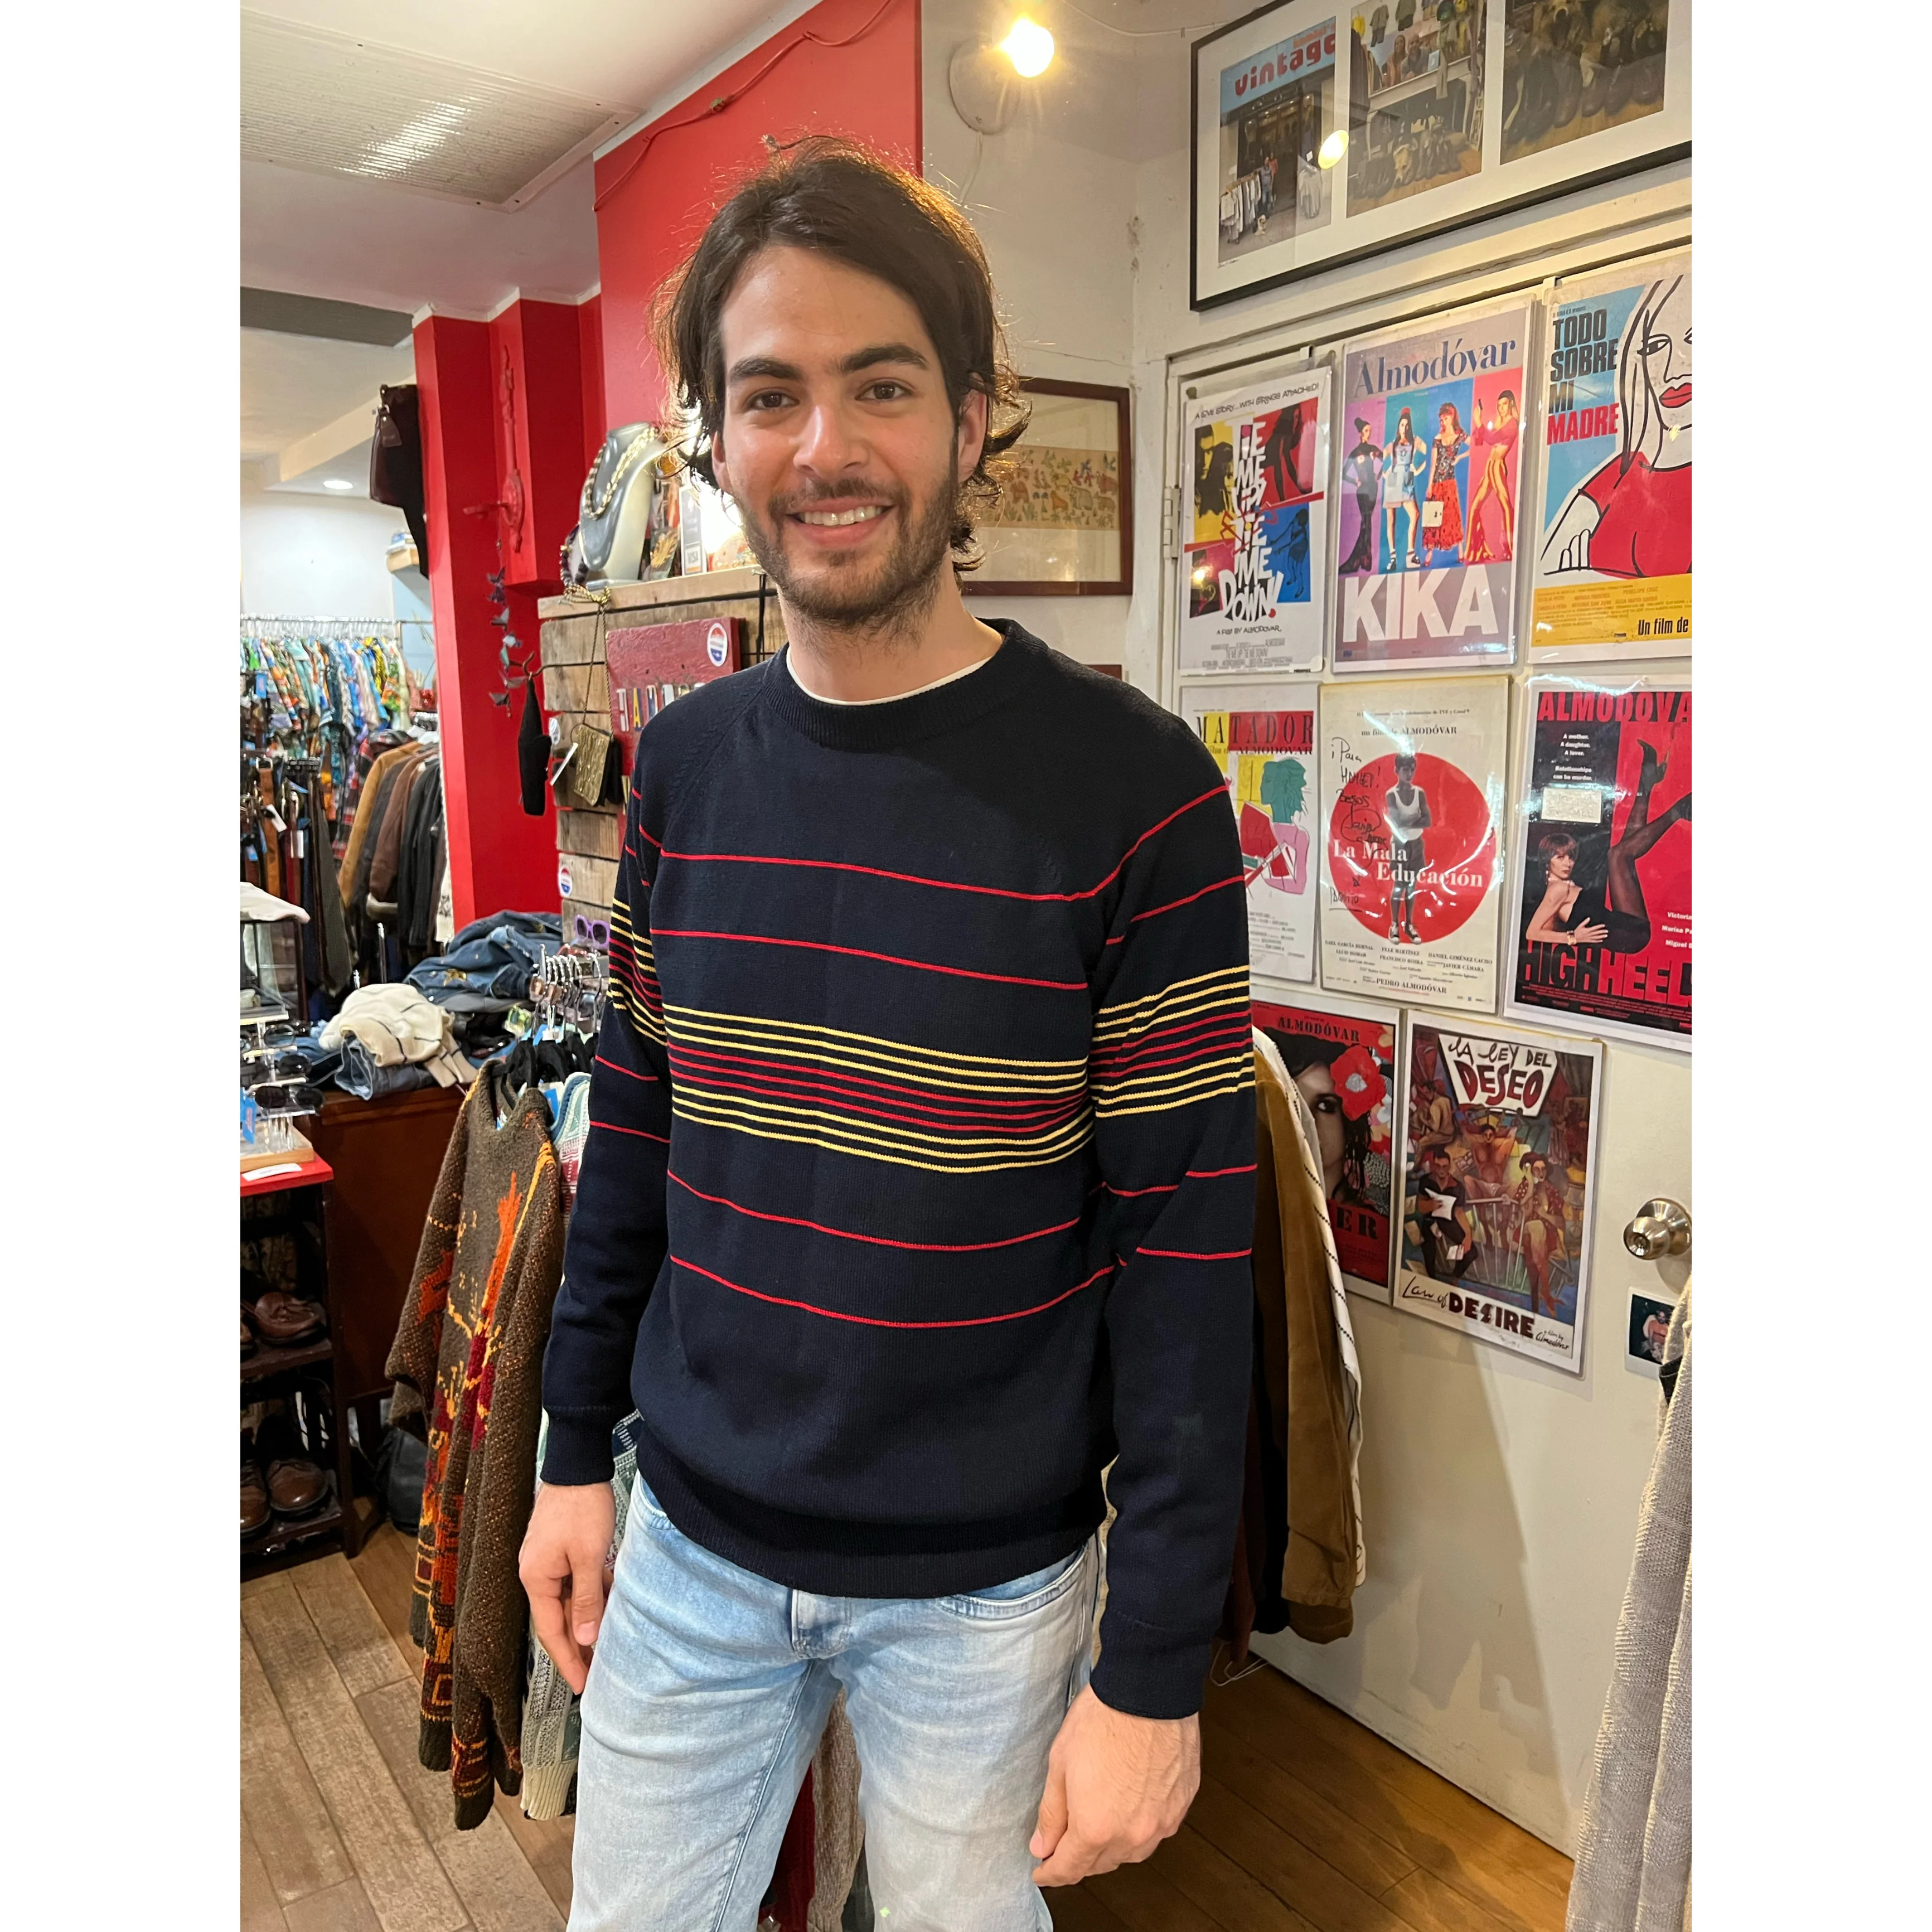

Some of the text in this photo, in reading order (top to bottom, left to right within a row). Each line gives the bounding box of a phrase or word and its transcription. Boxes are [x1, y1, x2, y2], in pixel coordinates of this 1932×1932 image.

[1553, 309, 1607, 350] TODO
[1354, 338, 1515, 398] Almodóvar
[1550, 338, 1618, 382] SOBRE
[1548, 380, 1575, 414] MI
[1224, 418, 1266, 464] TIE
[1547, 403, 1619, 446] MADRE
[1237, 456, 1266, 495] ME
[1230, 513, 1267, 551] TIE
[1238, 546, 1272, 589] ME
[1218, 569, 1284, 622] DOWN!
[1343, 564, 1499, 642] KIKA
[1638, 616, 1688, 636] Un film de
[1196, 713, 1314, 744] MATADOR
[1334, 839, 1407, 861] La Mala
[1377, 861, 1483, 888] Educación
[1376, 977, 1400, 987] PEDRO
[1402, 982, 1448, 994] ALMODÓVAR
[1519, 940, 1599, 991] HIGH
[1278, 1016, 1360, 1042] ALMODÓVAR
[1525, 1048, 1552, 1068] DEL
[1453, 1059, 1544, 1109] DESEO
[1402, 1276, 1435, 1300] Law
[1449, 1291, 1534, 1339] DESIRE
